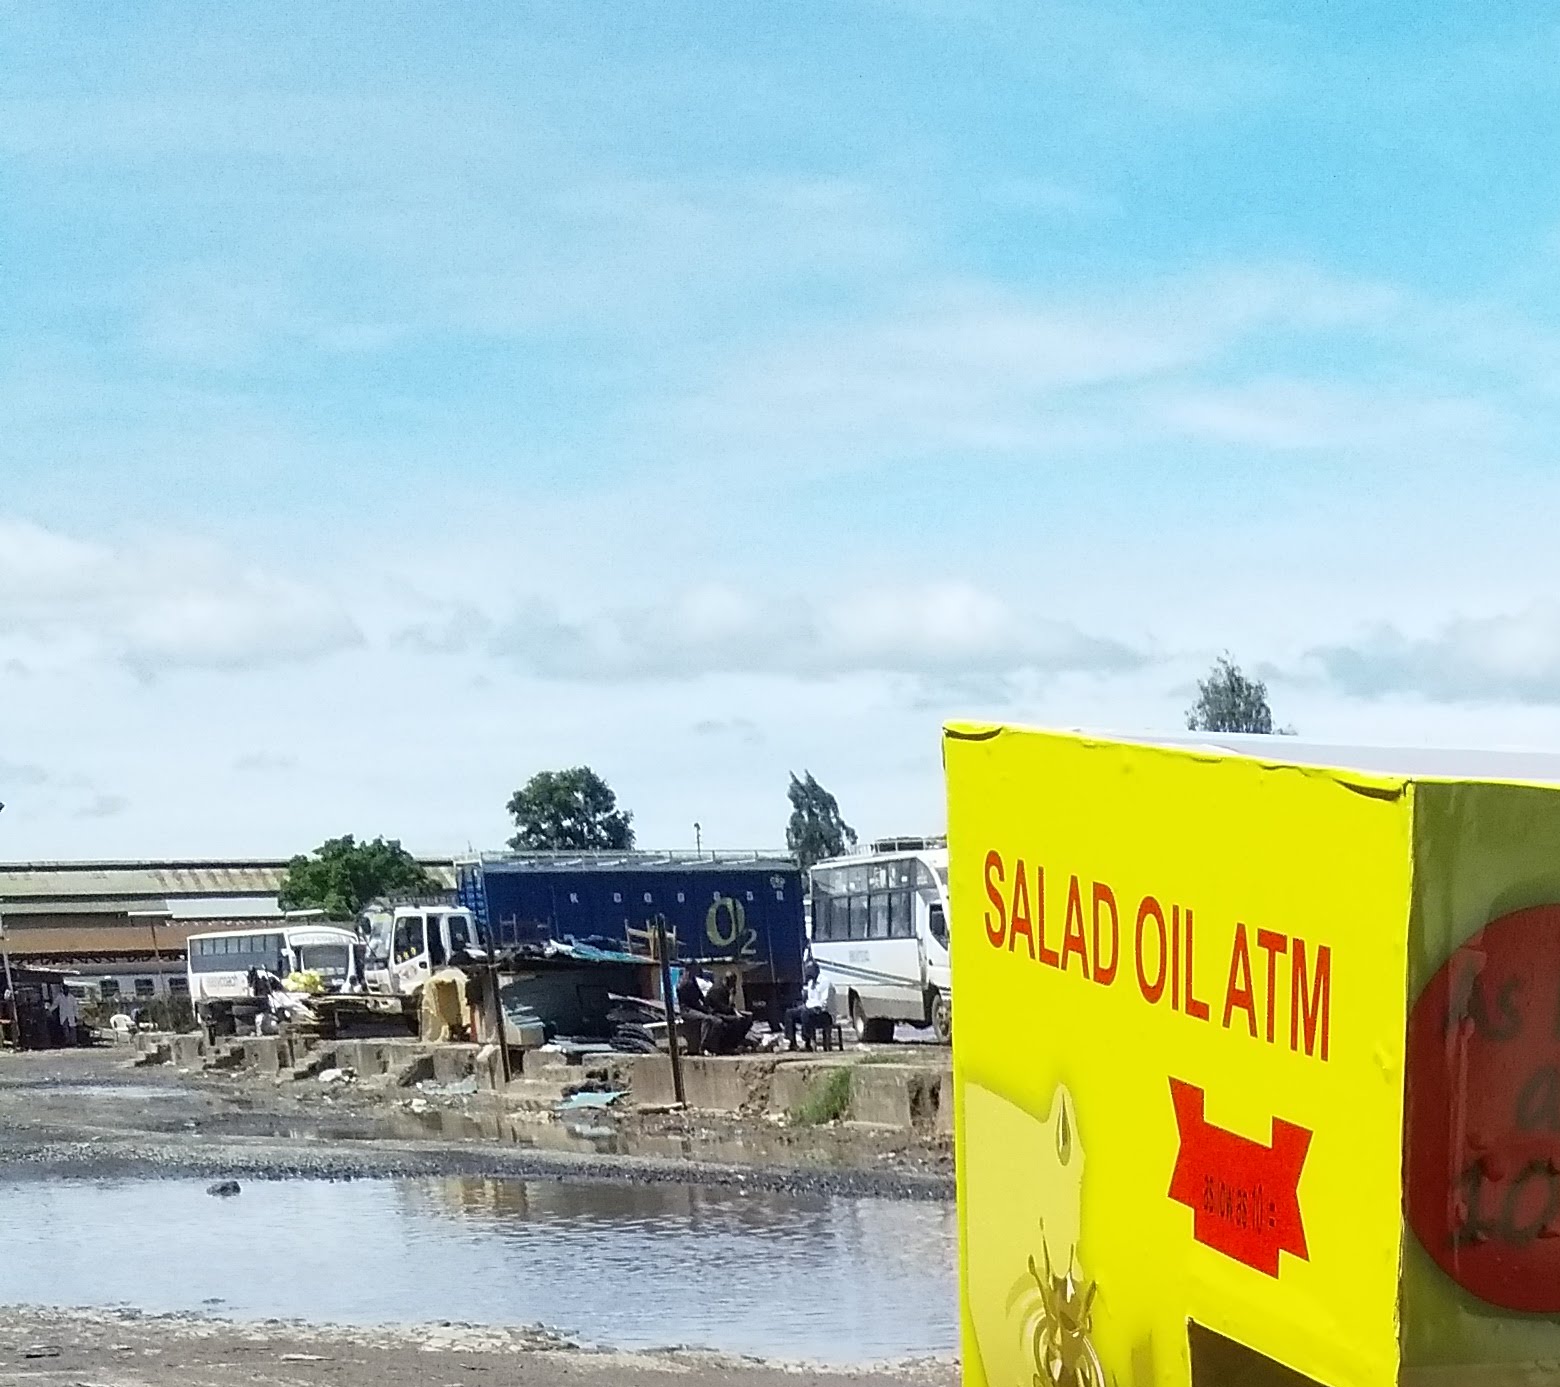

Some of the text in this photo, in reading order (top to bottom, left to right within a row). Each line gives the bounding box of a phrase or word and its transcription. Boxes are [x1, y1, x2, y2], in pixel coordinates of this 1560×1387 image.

[983, 849, 1332, 1062] SALAD OIL ATM
